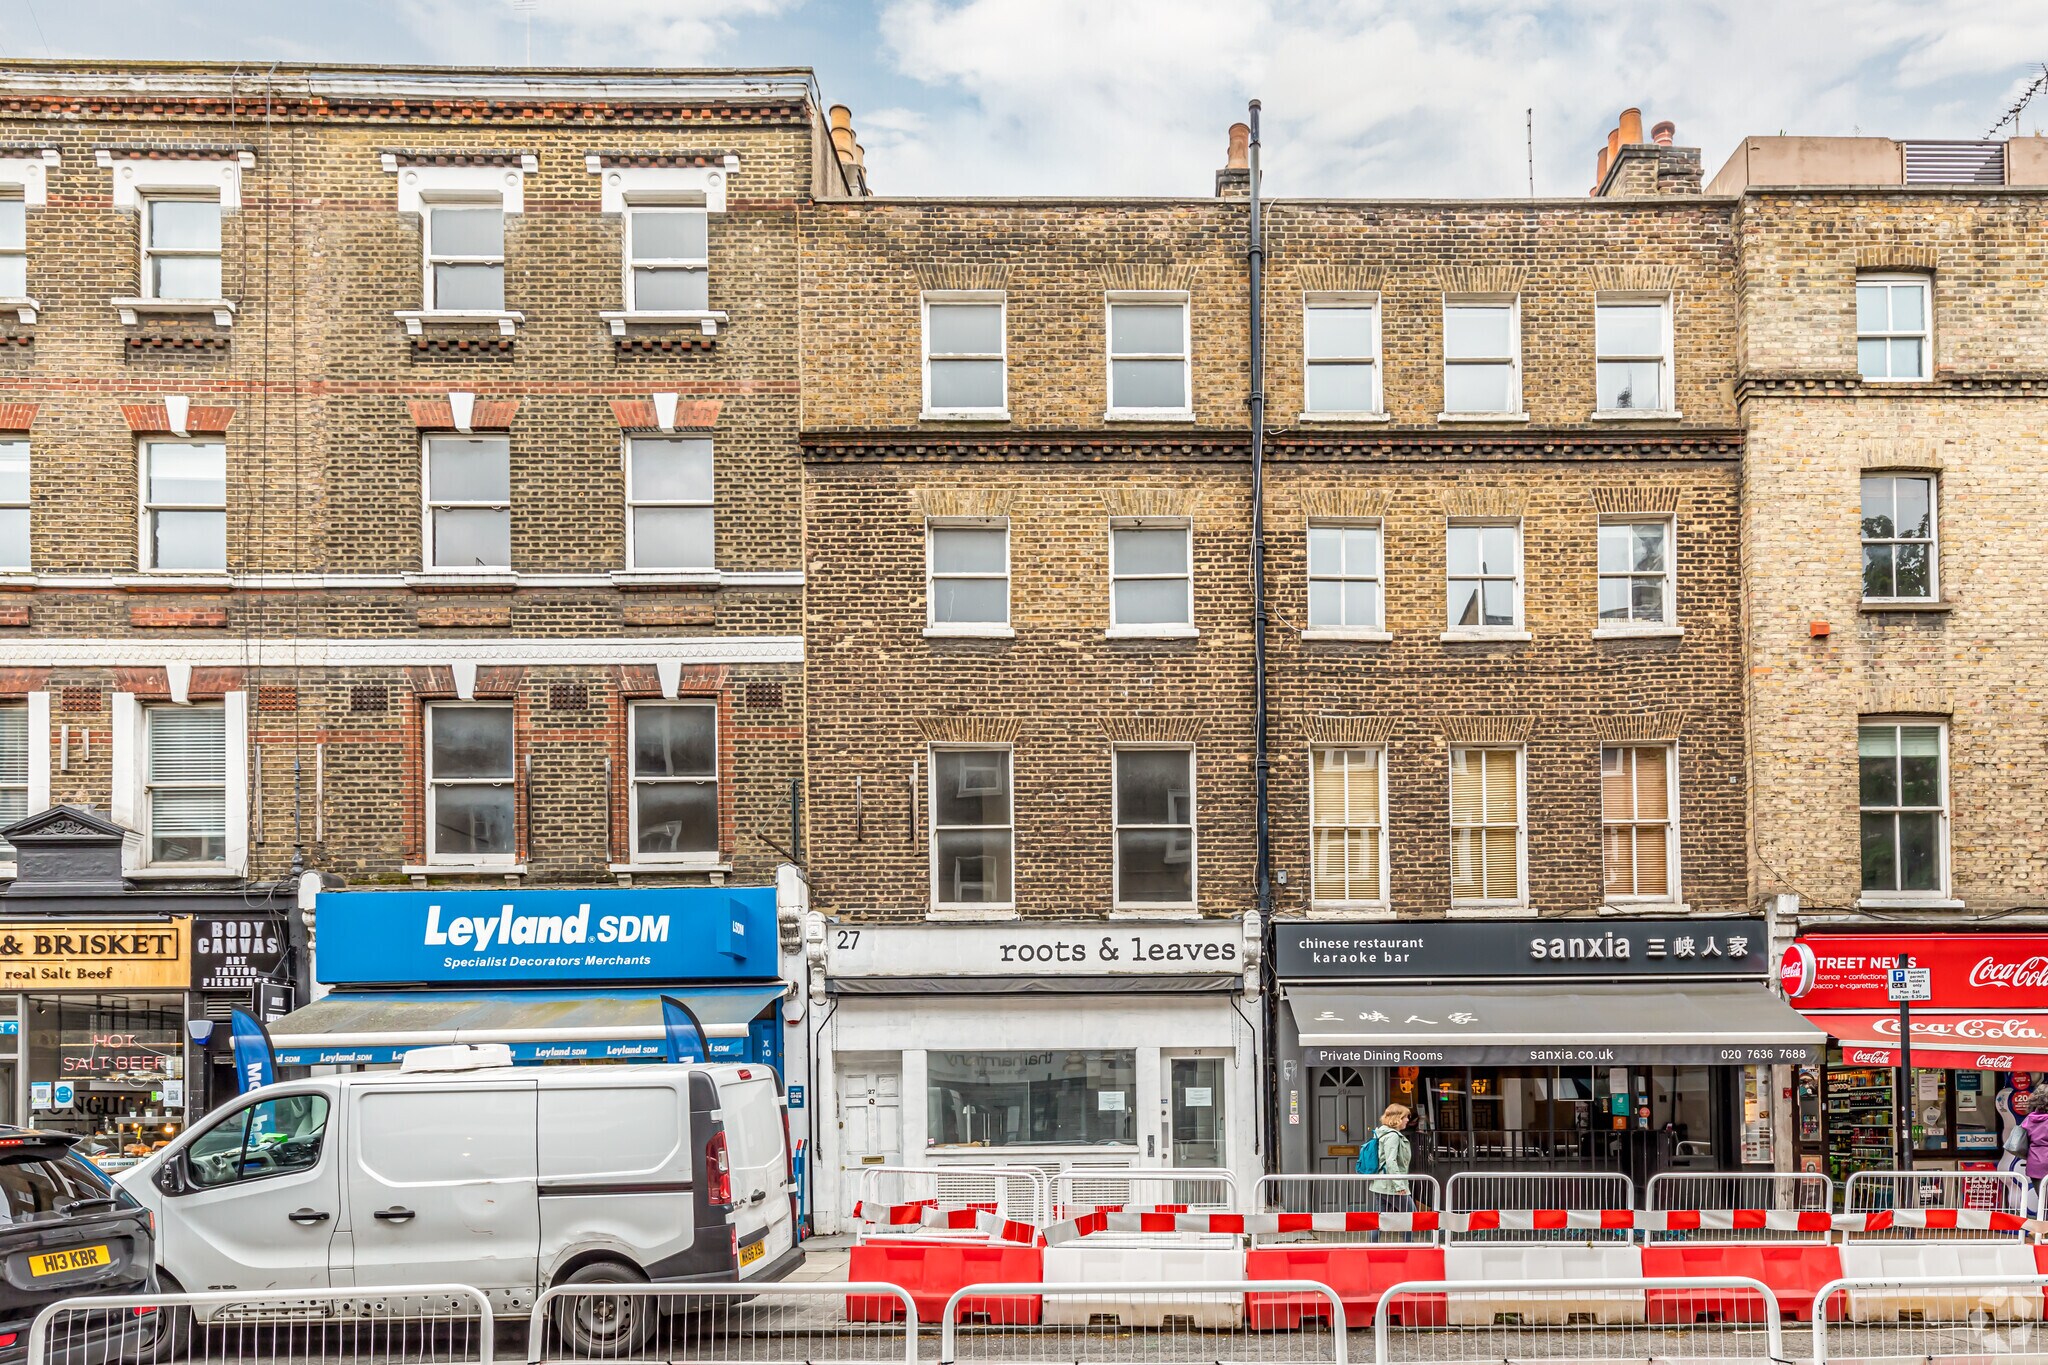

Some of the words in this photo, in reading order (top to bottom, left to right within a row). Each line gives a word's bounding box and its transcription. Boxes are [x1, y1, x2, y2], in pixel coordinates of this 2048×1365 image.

[211, 921, 265, 937] BODY
[424, 903, 591, 951] Leyland
[597, 915, 670, 942] SDM
[0, 935, 24, 955] &
[33, 934, 172, 955] BRISKET
[197, 937, 279, 954] CANVAS
[836, 930, 861, 950] 27
[1299, 938, 1349, 949] chinese
[1353, 938, 1424, 949] restaurant
[1530, 931, 1631, 959] sanxia
[1646, 935, 1749, 958] 三峡人家
[1000, 941, 1087, 962] roots
[1098, 936, 1120, 962] &
[1131, 936, 1236, 962] leaves
[225, 956, 247, 965] ART
[444, 956, 507, 970] Specialist
[585, 955, 651, 966] Merchants
[1313, 952, 1377, 963] karaoke
[1384, 952, 1410, 963] bar
[1814, 957, 1866, 969] TREET
[5, 967, 36, 979] real
[41, 967, 71, 979] Salt
[76, 966, 113, 979] Beef
[215, 967, 257, 976] TATTOO
[1781, 962, 1801, 979] Coca-Cola
[1817, 973, 1841, 981] licence
[1848, 973, 1888, 981] confectione
[1840, 982, 1879, 990] e-cigarettes
[92, 1034, 136, 1048] HOT
[536, 1047, 571, 1058] Leyland
[572, 1048, 588, 1056] SDM
[607, 1045, 642, 1056] Leyland
[643, 1046, 659, 1054] SDM
[1320, 1051, 1361, 1061] Private
[1363, 1051, 1400, 1063] Dining
[1403, 1050, 1443, 1061] Rooms
[1530, 1049, 1614, 1060] sanxia.co.uk
[1721, 1050, 1742, 1059] 020
[1747, 1050, 1773, 1059] 7636
[1779, 1049, 1806, 1059] 7688
[1853, 1050, 1891, 1064] Coca-Cola
[63, 1056, 109, 1071] SALT
[116, 1056, 165, 1070] BEEF
[285, 1055, 301, 1063] SDM
[320, 1052, 355, 1063] Leyland
[1976, 1054, 2014, 1068] Coca-Cola
[69, 1249, 98, 1268] KBR
